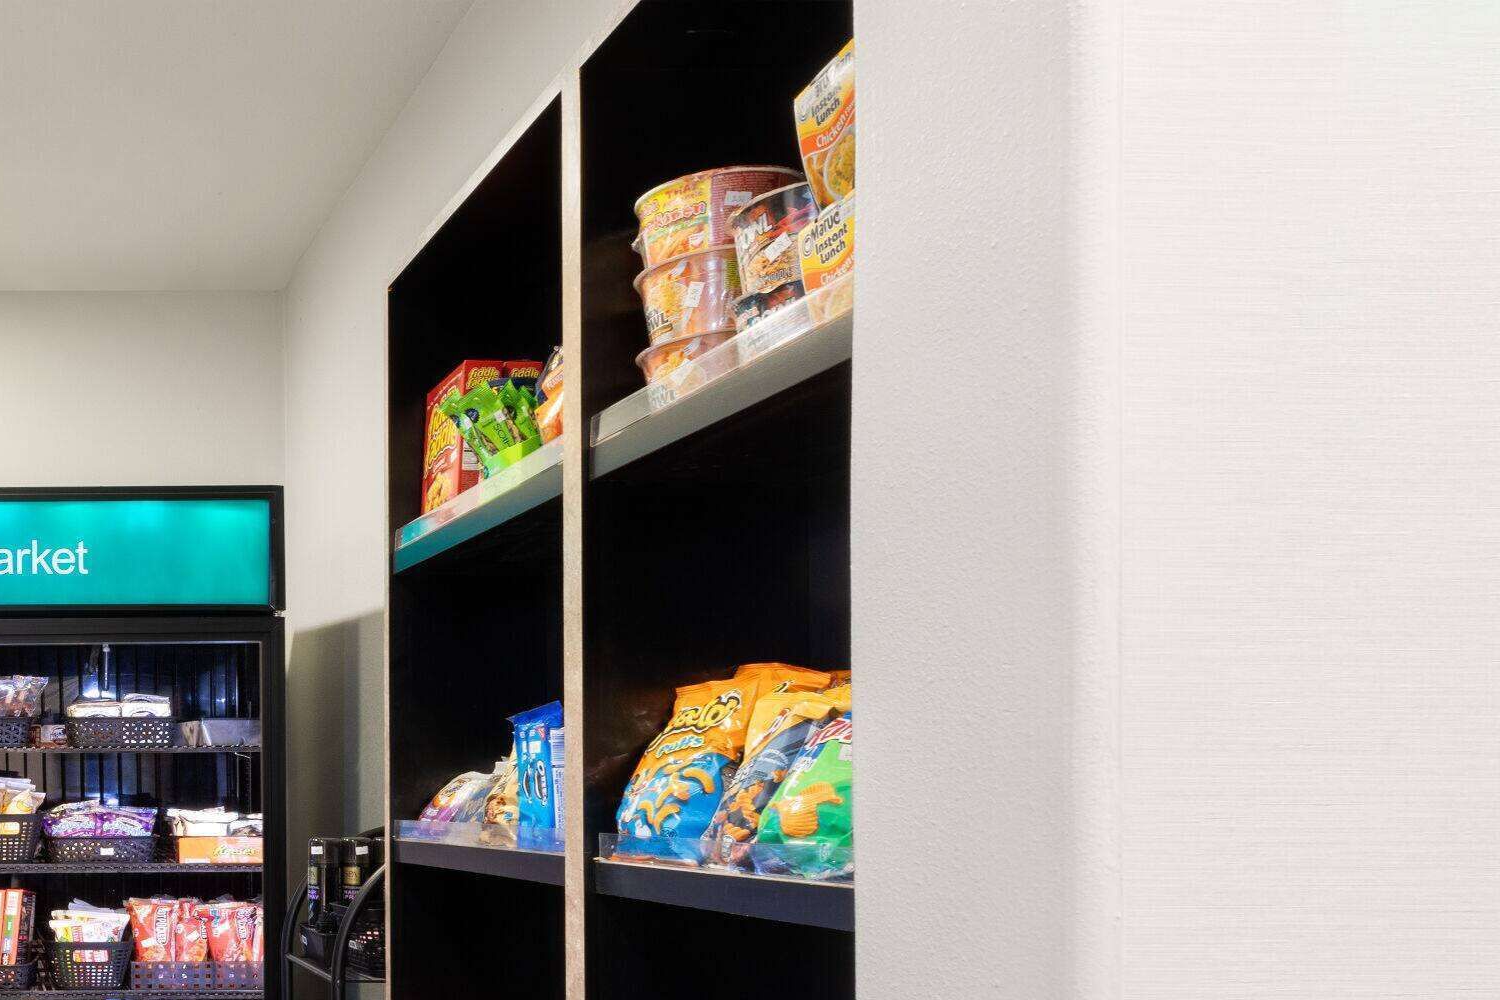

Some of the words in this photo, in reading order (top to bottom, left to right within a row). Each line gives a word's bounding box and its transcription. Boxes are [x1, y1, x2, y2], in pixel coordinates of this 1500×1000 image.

[811, 211, 840, 242] Maruc
[815, 222, 848, 255] Instant
[820, 239, 847, 264] Lunch
